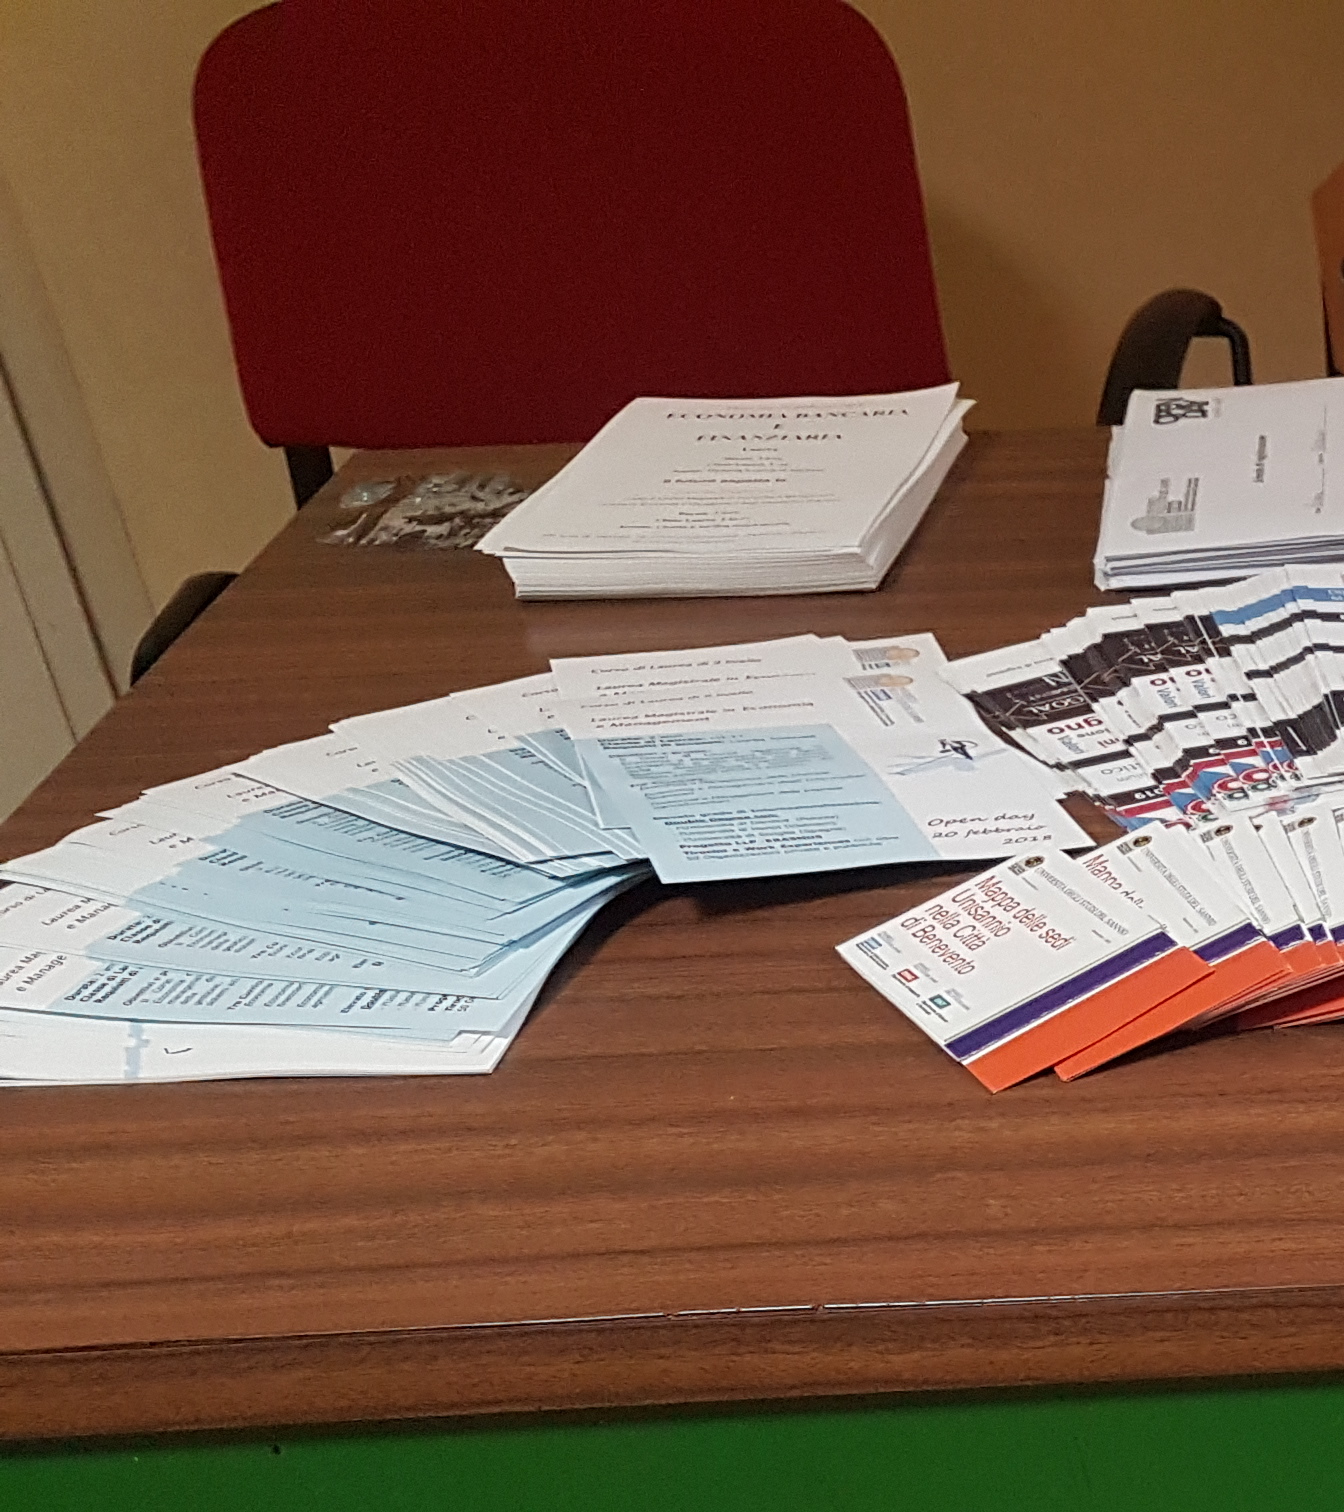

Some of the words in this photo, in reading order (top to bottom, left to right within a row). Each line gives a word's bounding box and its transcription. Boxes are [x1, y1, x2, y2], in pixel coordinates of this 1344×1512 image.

[666, 411, 787, 419] ECONOMIA
[795, 408, 910, 419] BANCARIA
[696, 433, 843, 441] FINANZIARIA
[590, 715, 639, 723] Laurea
[644, 708, 718, 719] Magistrale
[742, 702, 815, 713] Economia
[608, 716, 711, 728] Management
[927, 815, 989, 829] Open
[994, 811, 1036, 825] day
[931, 830, 960, 840] 20
[964, 824, 1049, 840] febbraio
[1002, 833, 1054, 846] 2018
[952, 888, 1012, 939] Unisannio
[974, 874, 1016, 914] Mappa
[1012, 906, 1046, 934] delle
[1038, 926, 1076, 953] sedi
[924, 903, 961, 931] nella
[953, 922, 991, 952] Città
[900, 916, 922, 936] di
[911, 922, 978, 976] Benevento
